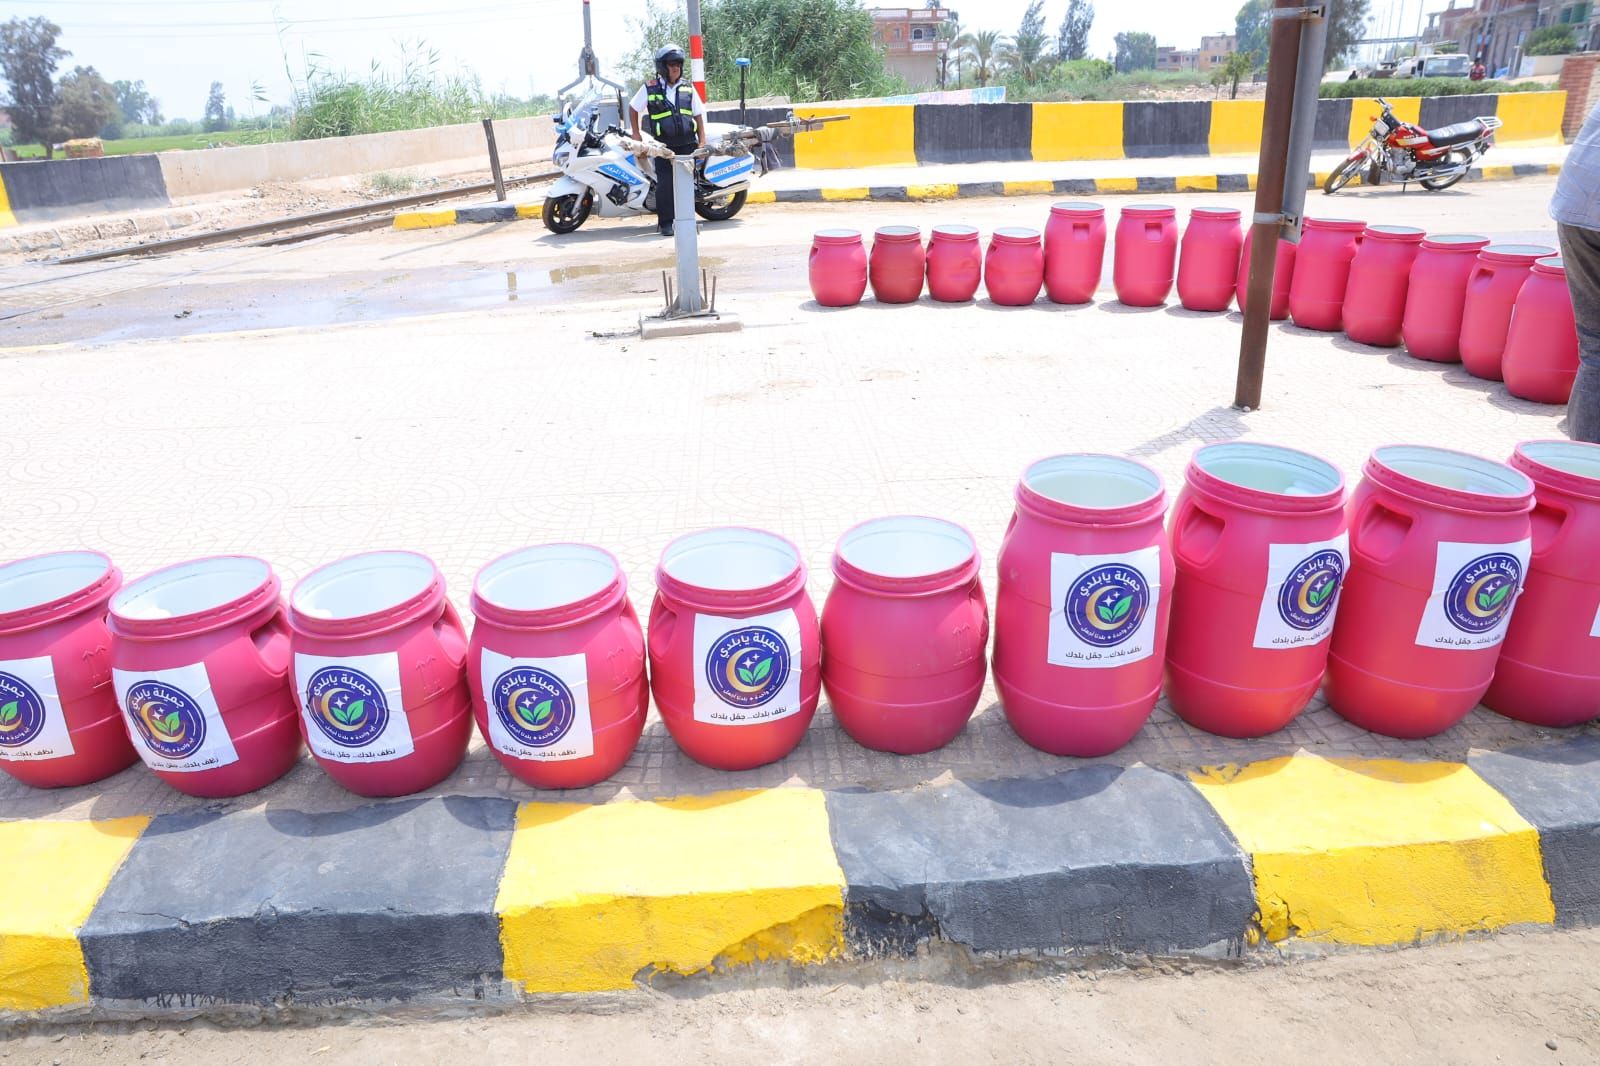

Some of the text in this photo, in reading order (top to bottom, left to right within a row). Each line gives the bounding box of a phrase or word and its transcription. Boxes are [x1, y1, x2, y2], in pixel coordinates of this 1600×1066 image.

[1296, 556, 1342, 583] جميلة يابلدي
[1465, 559, 1518, 584] جميلة يابلدي
[1080, 570, 1140, 597] جميلة يابلدي
[720, 632, 780, 658] جميلة يابلدي
[0, 679, 25, 698] جميل
[313, 674, 372, 697] جميلة يابلدي
[501, 674, 560, 697] جميلة يابلدي
[153, 687, 185, 709] جميلة
